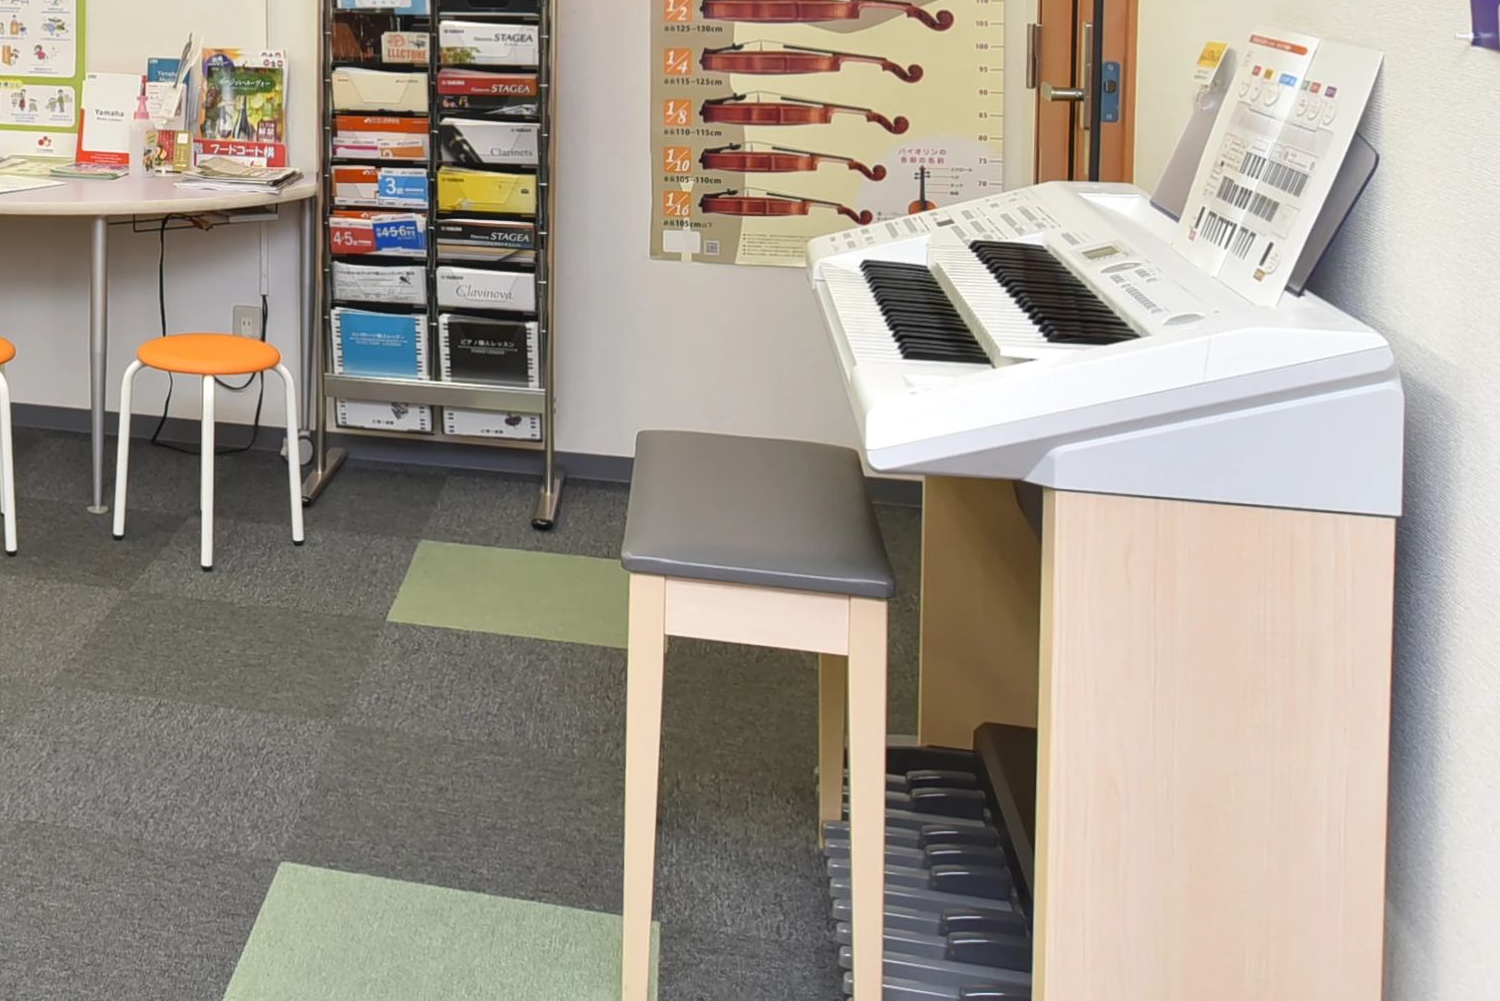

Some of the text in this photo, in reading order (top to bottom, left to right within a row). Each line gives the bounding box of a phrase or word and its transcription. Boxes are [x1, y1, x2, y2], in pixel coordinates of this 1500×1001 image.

[494, 34, 533, 43] STAGEA
[491, 84, 531, 93] STAGEA
[95, 109, 124, 117] Yamaha
[491, 148, 533, 157] Clarinets
[491, 232, 530, 242] STAGEA
[455, 285, 513, 300] Clavinova
